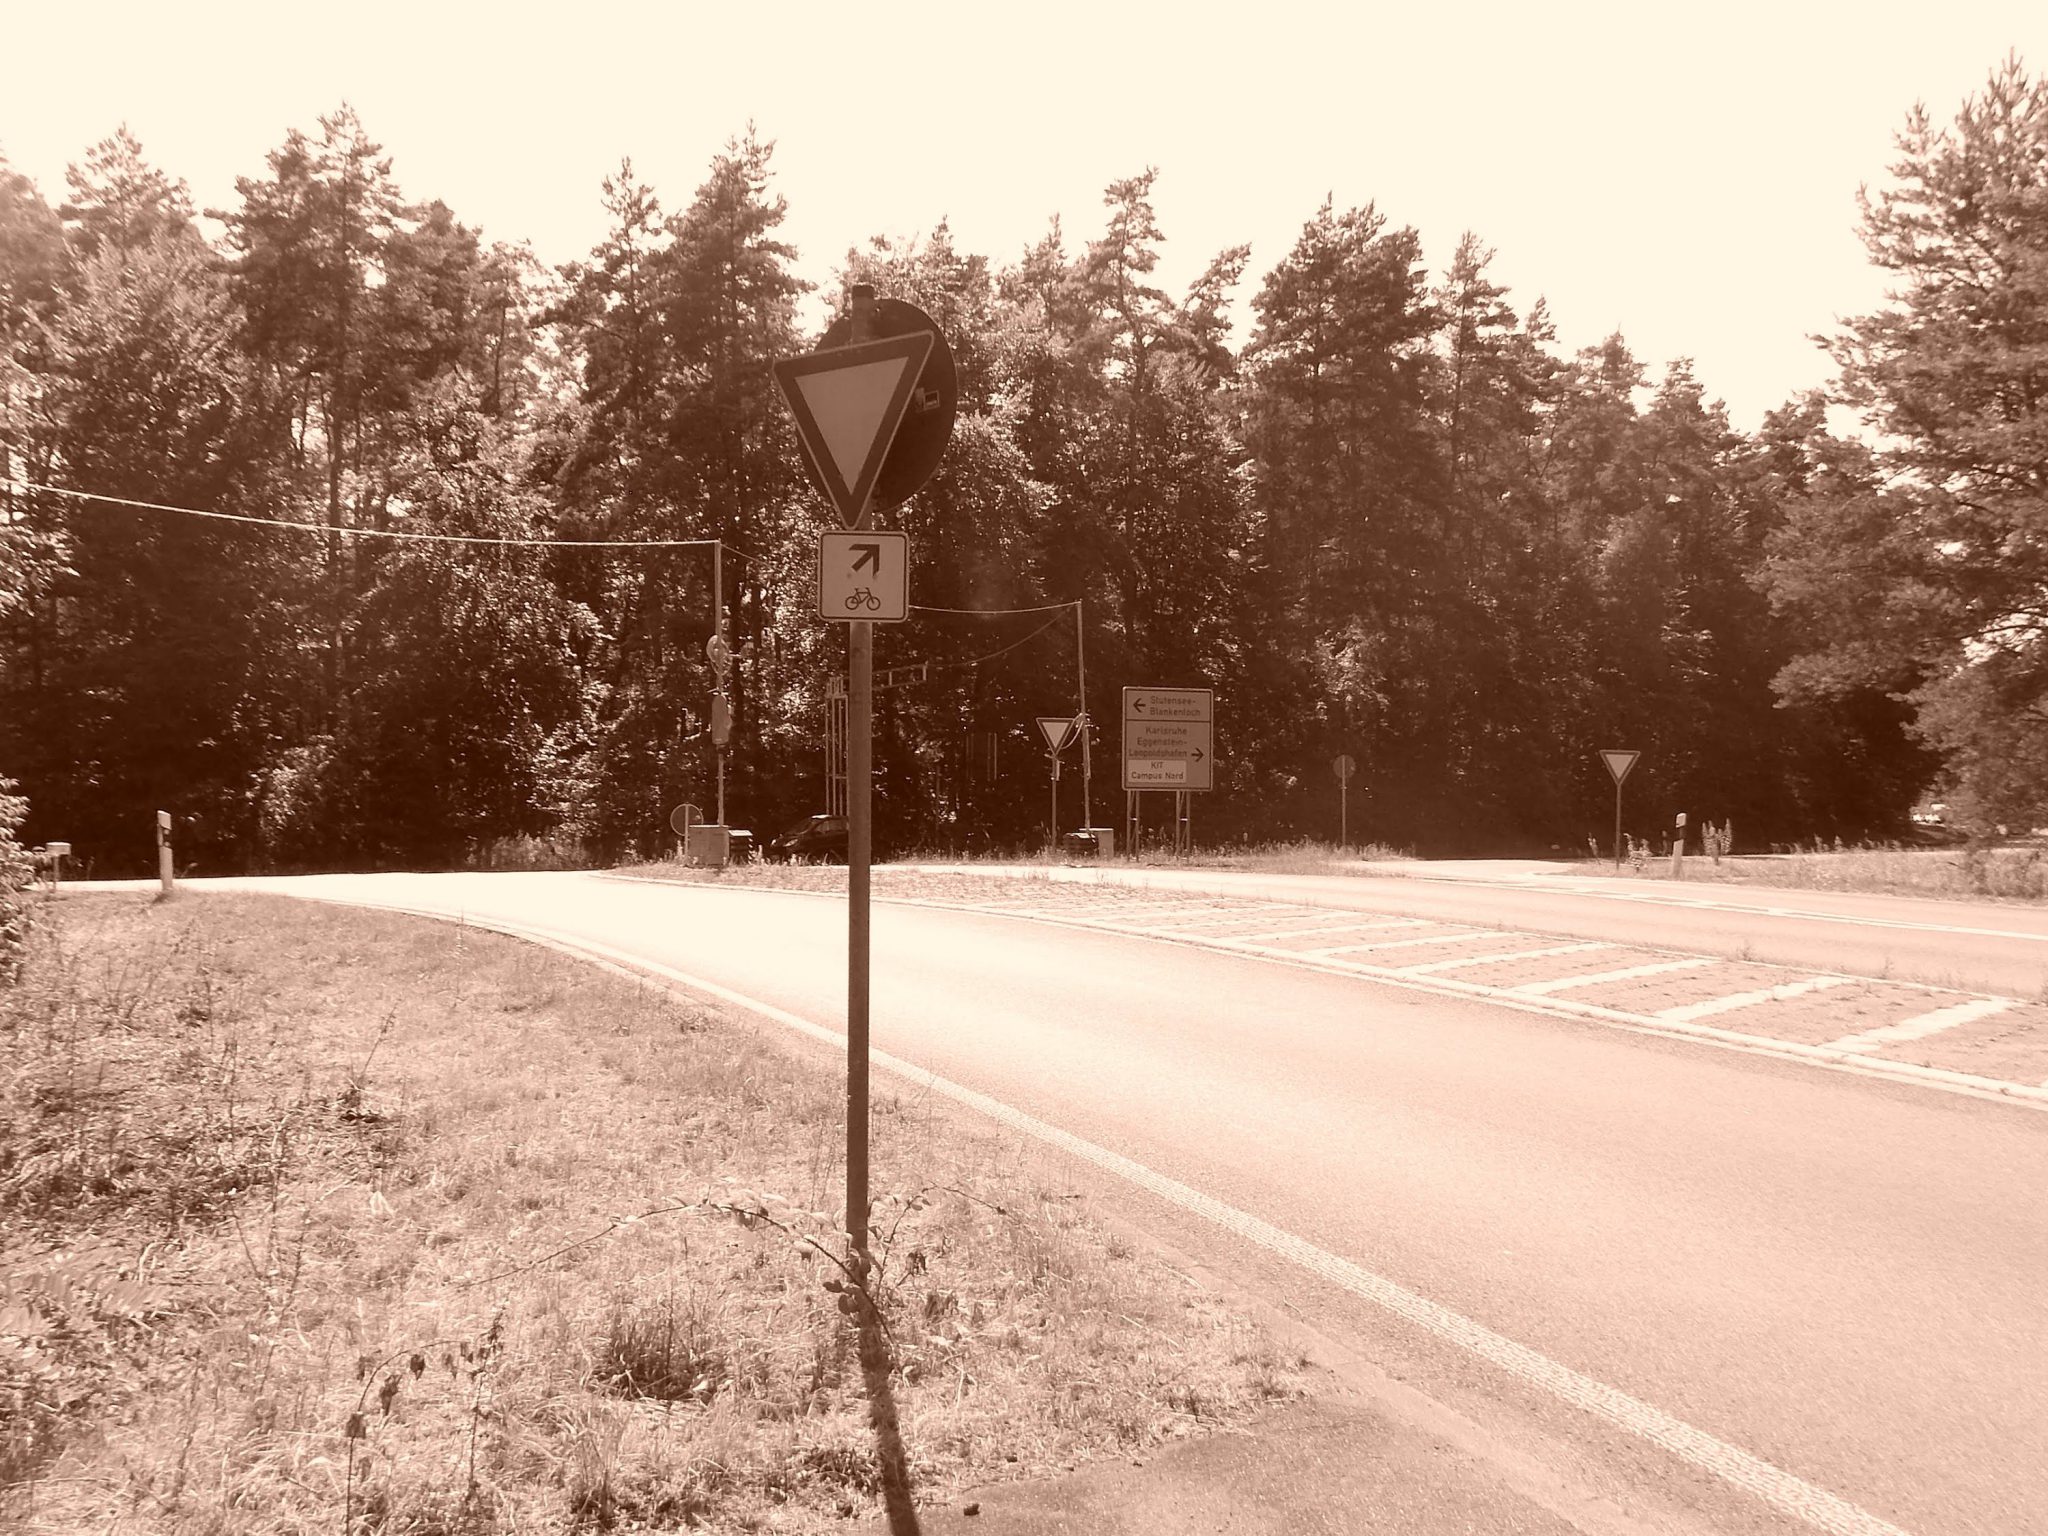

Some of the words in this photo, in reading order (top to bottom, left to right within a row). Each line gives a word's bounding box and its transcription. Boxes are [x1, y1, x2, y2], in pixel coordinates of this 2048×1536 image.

[1146, 727, 1187, 735] Karlsruhe
[1137, 737, 1187, 747] Eggenstein-
[1131, 772, 1162, 781] Campus
[1165, 772, 1183, 780] Nord
